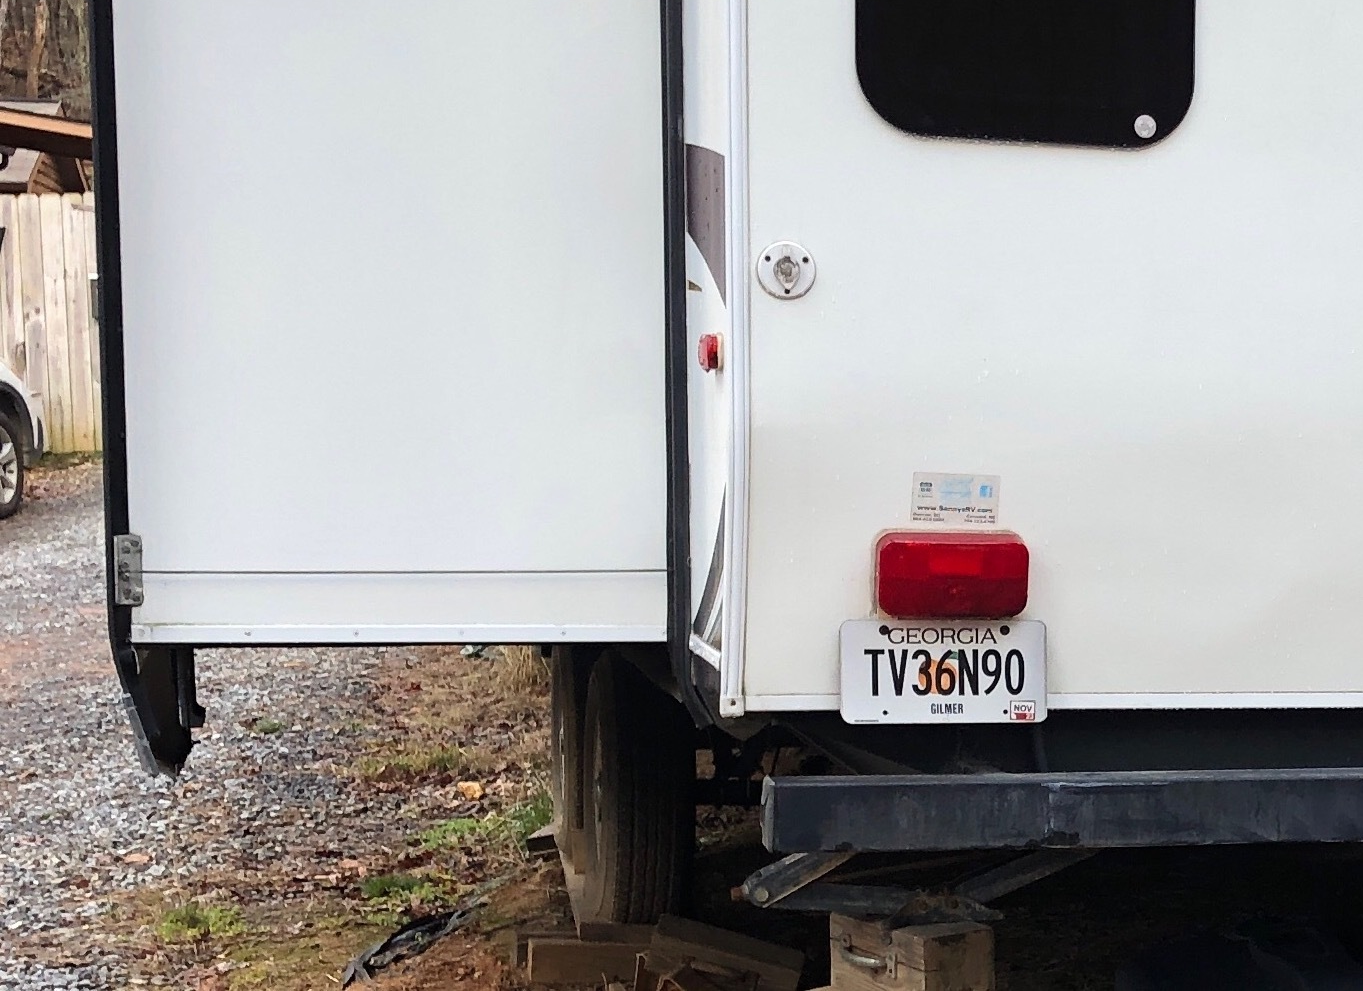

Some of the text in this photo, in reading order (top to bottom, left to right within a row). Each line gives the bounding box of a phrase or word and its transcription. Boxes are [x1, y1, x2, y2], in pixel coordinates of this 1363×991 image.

[888, 627, 998, 645] GEORGIA
[864, 648, 1025, 697] TV36N90
[930, 703, 964, 715] GILMER
[1013, 704, 1032, 712] NOV
